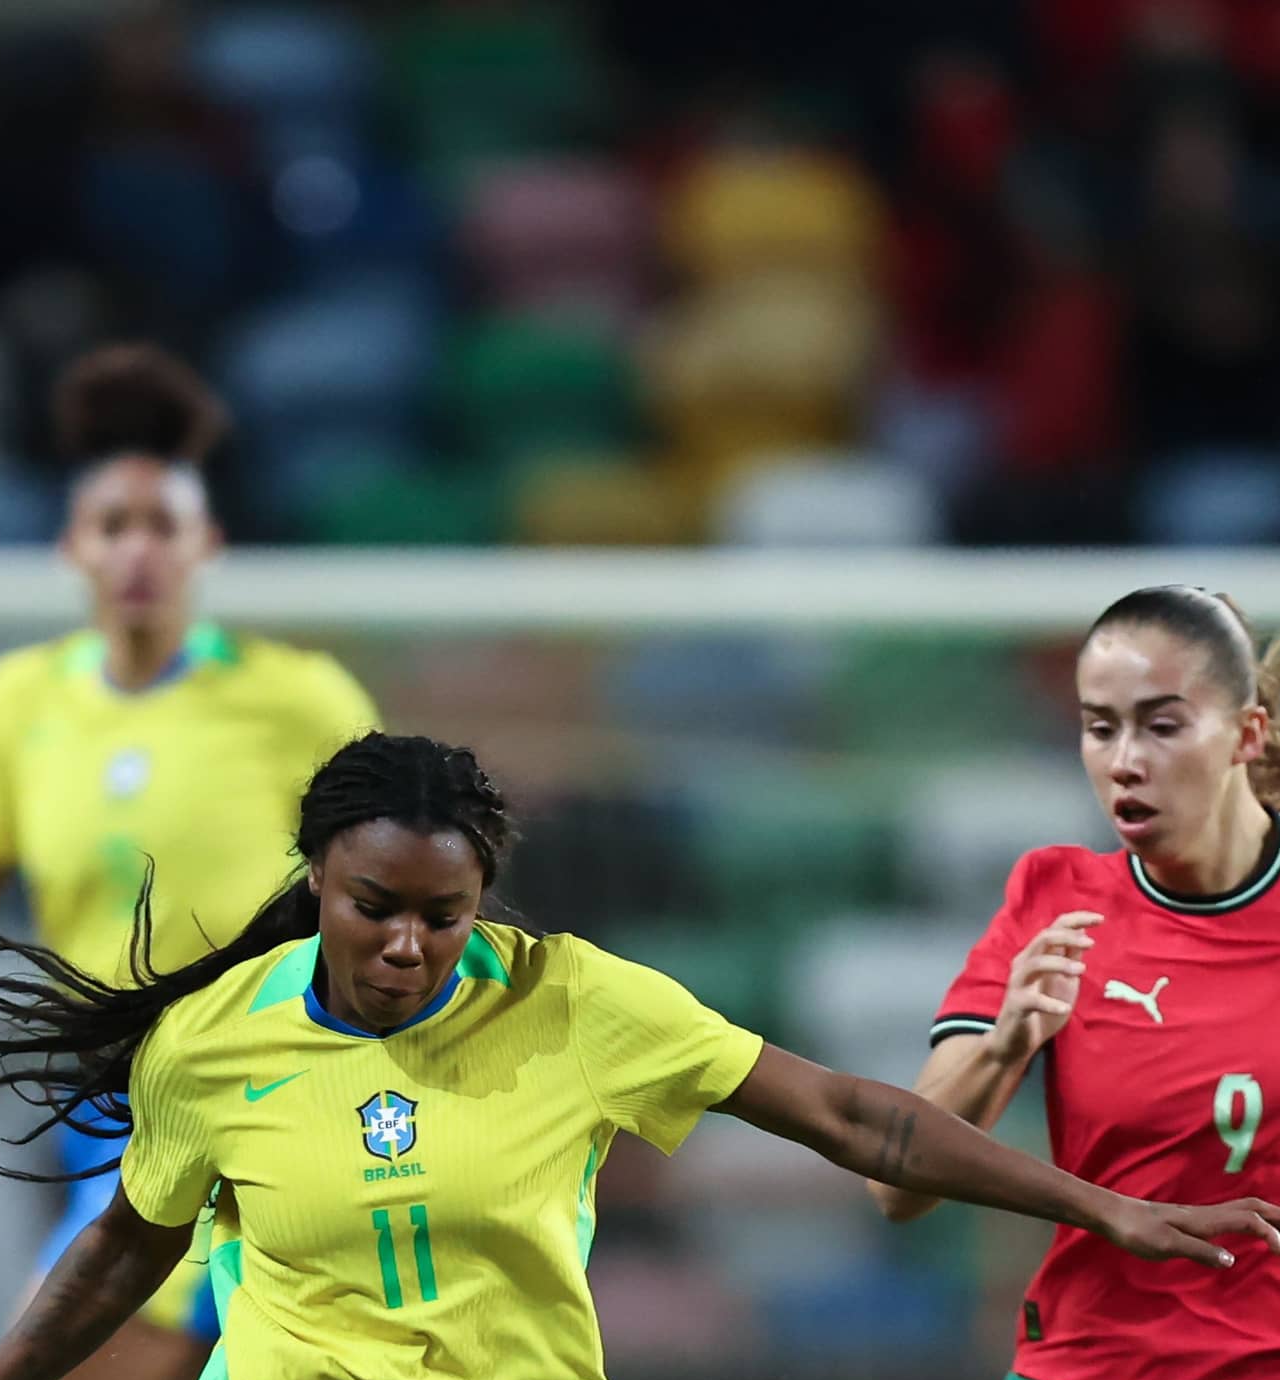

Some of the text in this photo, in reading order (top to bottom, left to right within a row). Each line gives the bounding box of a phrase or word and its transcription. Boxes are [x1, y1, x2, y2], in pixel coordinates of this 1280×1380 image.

[377, 1119, 400, 1130] CBF
[1214, 1073, 1263, 1173] 9
[363, 1162, 426, 1182] BRASIL
[372, 1204, 439, 1309] 11
